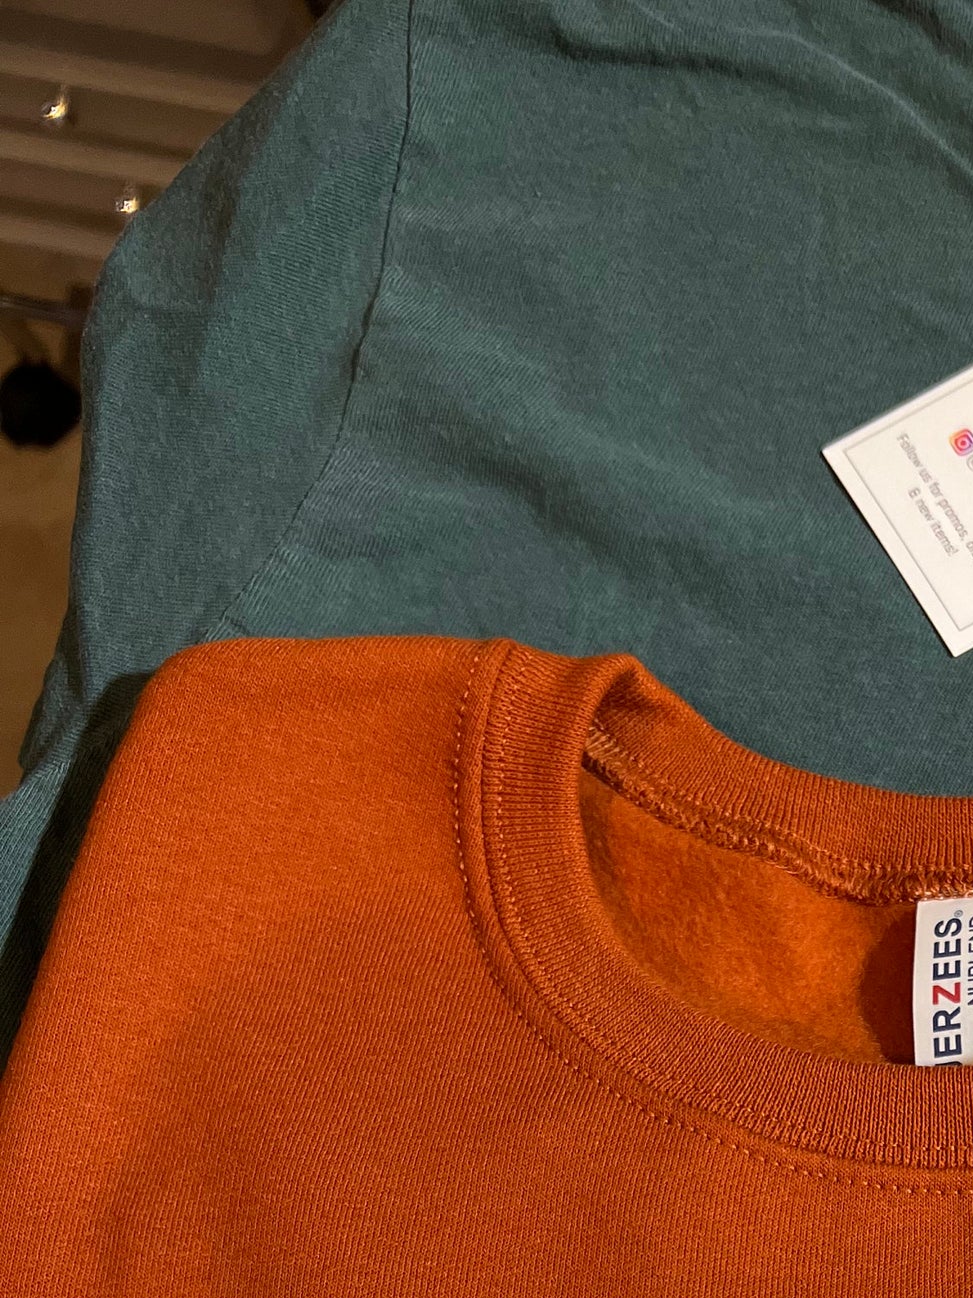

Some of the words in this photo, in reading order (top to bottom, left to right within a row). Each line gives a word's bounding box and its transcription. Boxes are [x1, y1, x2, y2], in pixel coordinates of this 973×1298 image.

[896, 433, 923, 468] Follow
[919, 468, 932, 483] us
[928, 481, 944, 498] for
[915, 499, 935, 522] new
[930, 519, 959, 557] items!
[932, 917, 964, 1067] ERZEES
